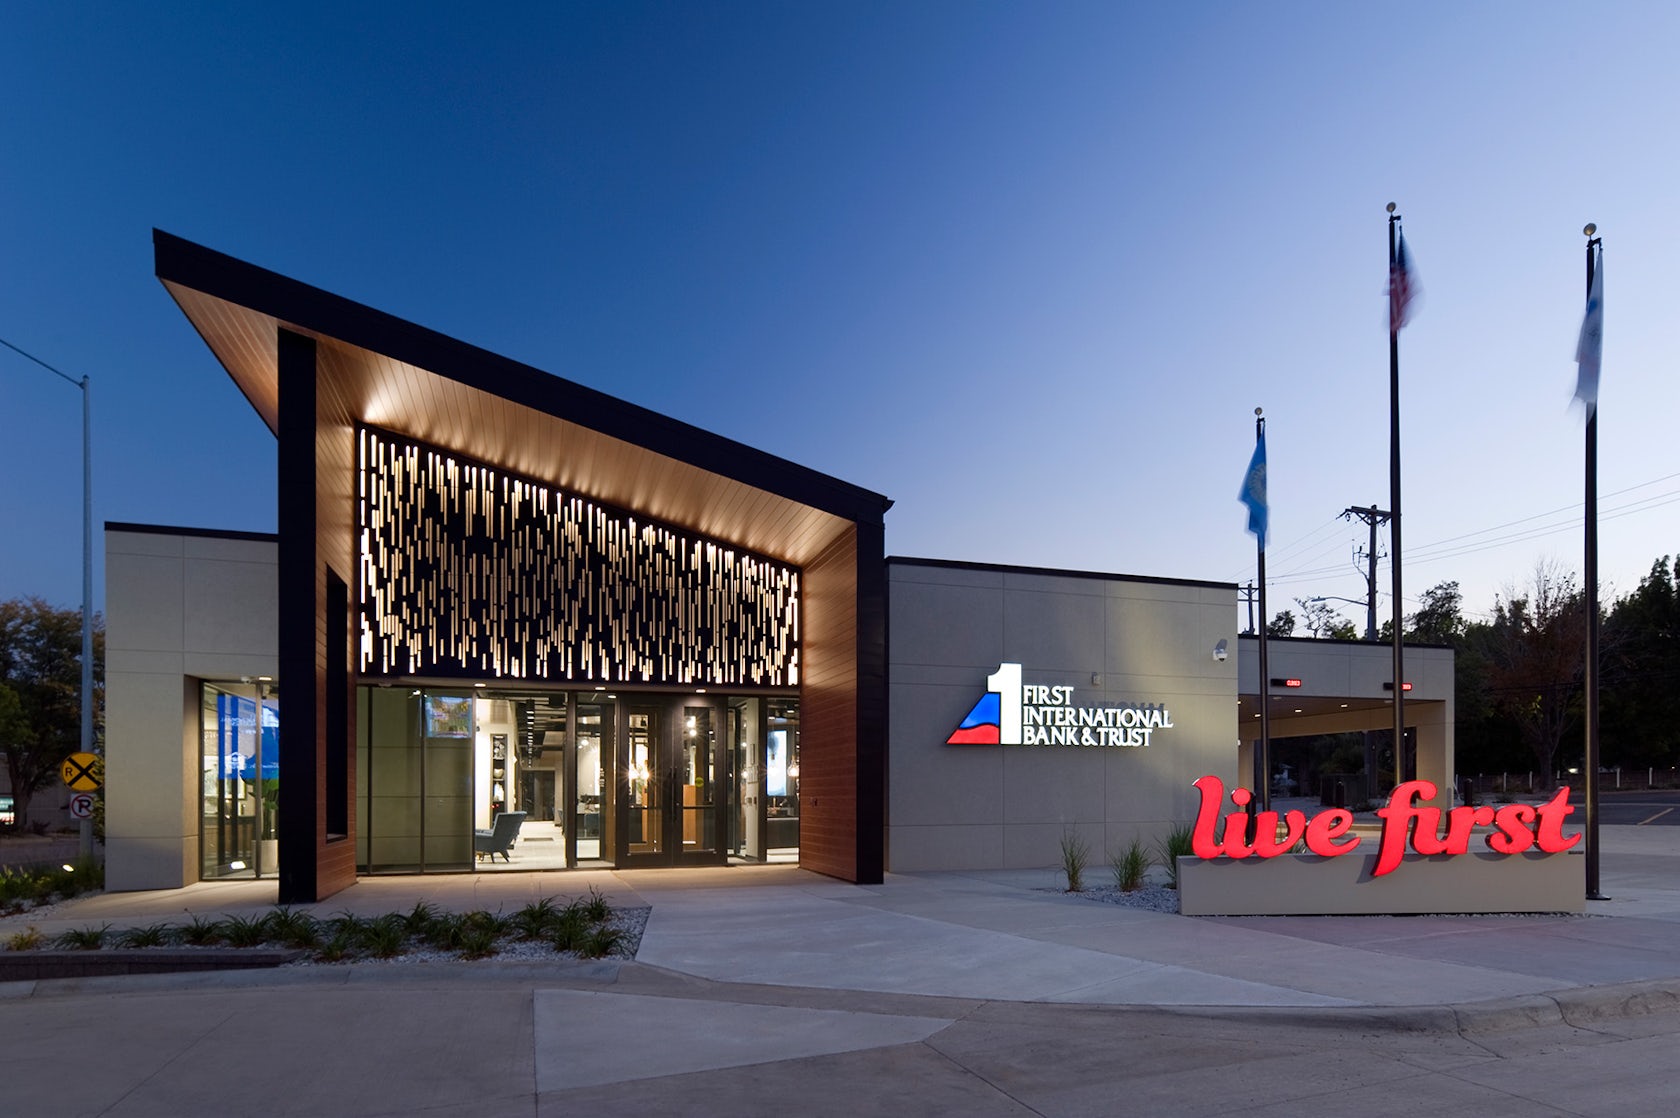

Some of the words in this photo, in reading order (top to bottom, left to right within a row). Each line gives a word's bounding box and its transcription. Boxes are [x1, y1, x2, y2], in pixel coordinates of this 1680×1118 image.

[988, 663, 1022, 745] 1
[1023, 685, 1074, 706] FIRST
[1023, 705, 1174, 728] INTERNATIONAL
[1023, 726, 1080, 746] BANK
[1081, 727, 1099, 746] &
[1097, 728, 1153, 747] TRUST
[65, 767, 73, 777] R
[1191, 775, 1362, 859] live
[1371, 779, 1583, 876] first
